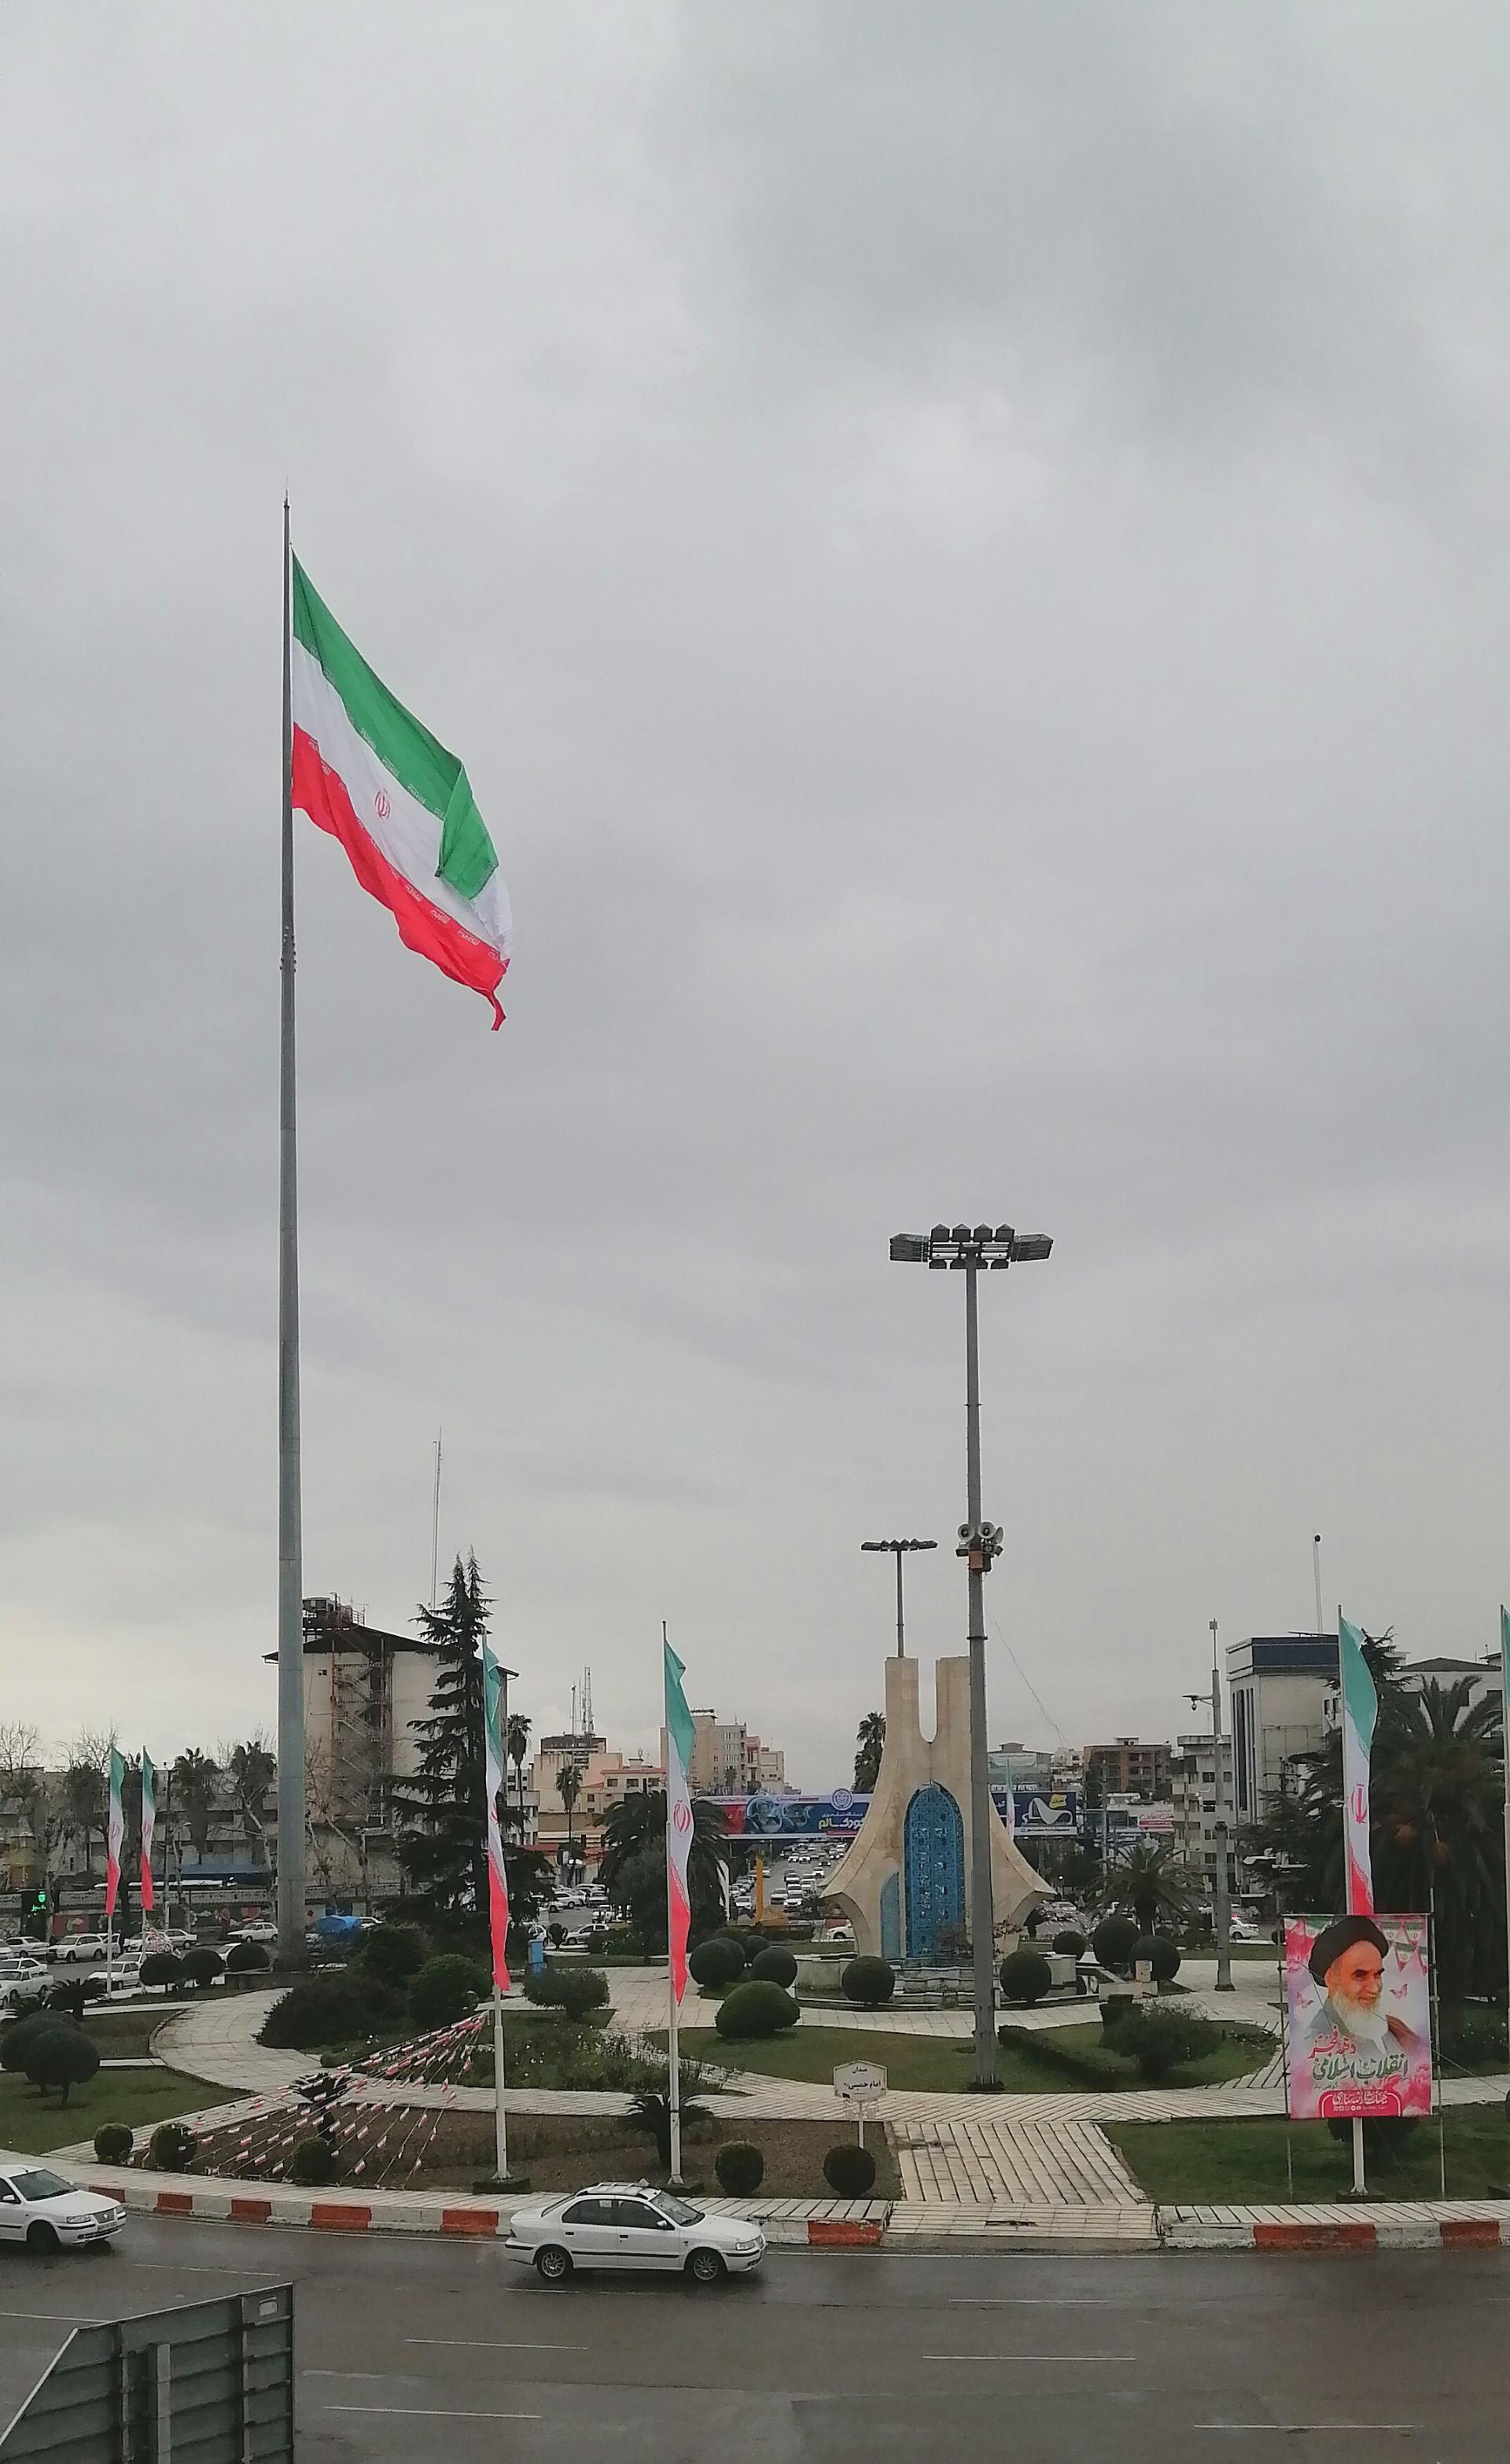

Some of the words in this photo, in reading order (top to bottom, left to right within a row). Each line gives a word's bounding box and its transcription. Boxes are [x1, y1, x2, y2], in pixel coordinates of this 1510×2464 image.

[1308, 2025, 1338, 2059] فجر
[852, 2066, 867, 2075] میدان
[1313, 2057, 1355, 2080] اسلامی
[1357, 2053, 1408, 2084] انقلاب
